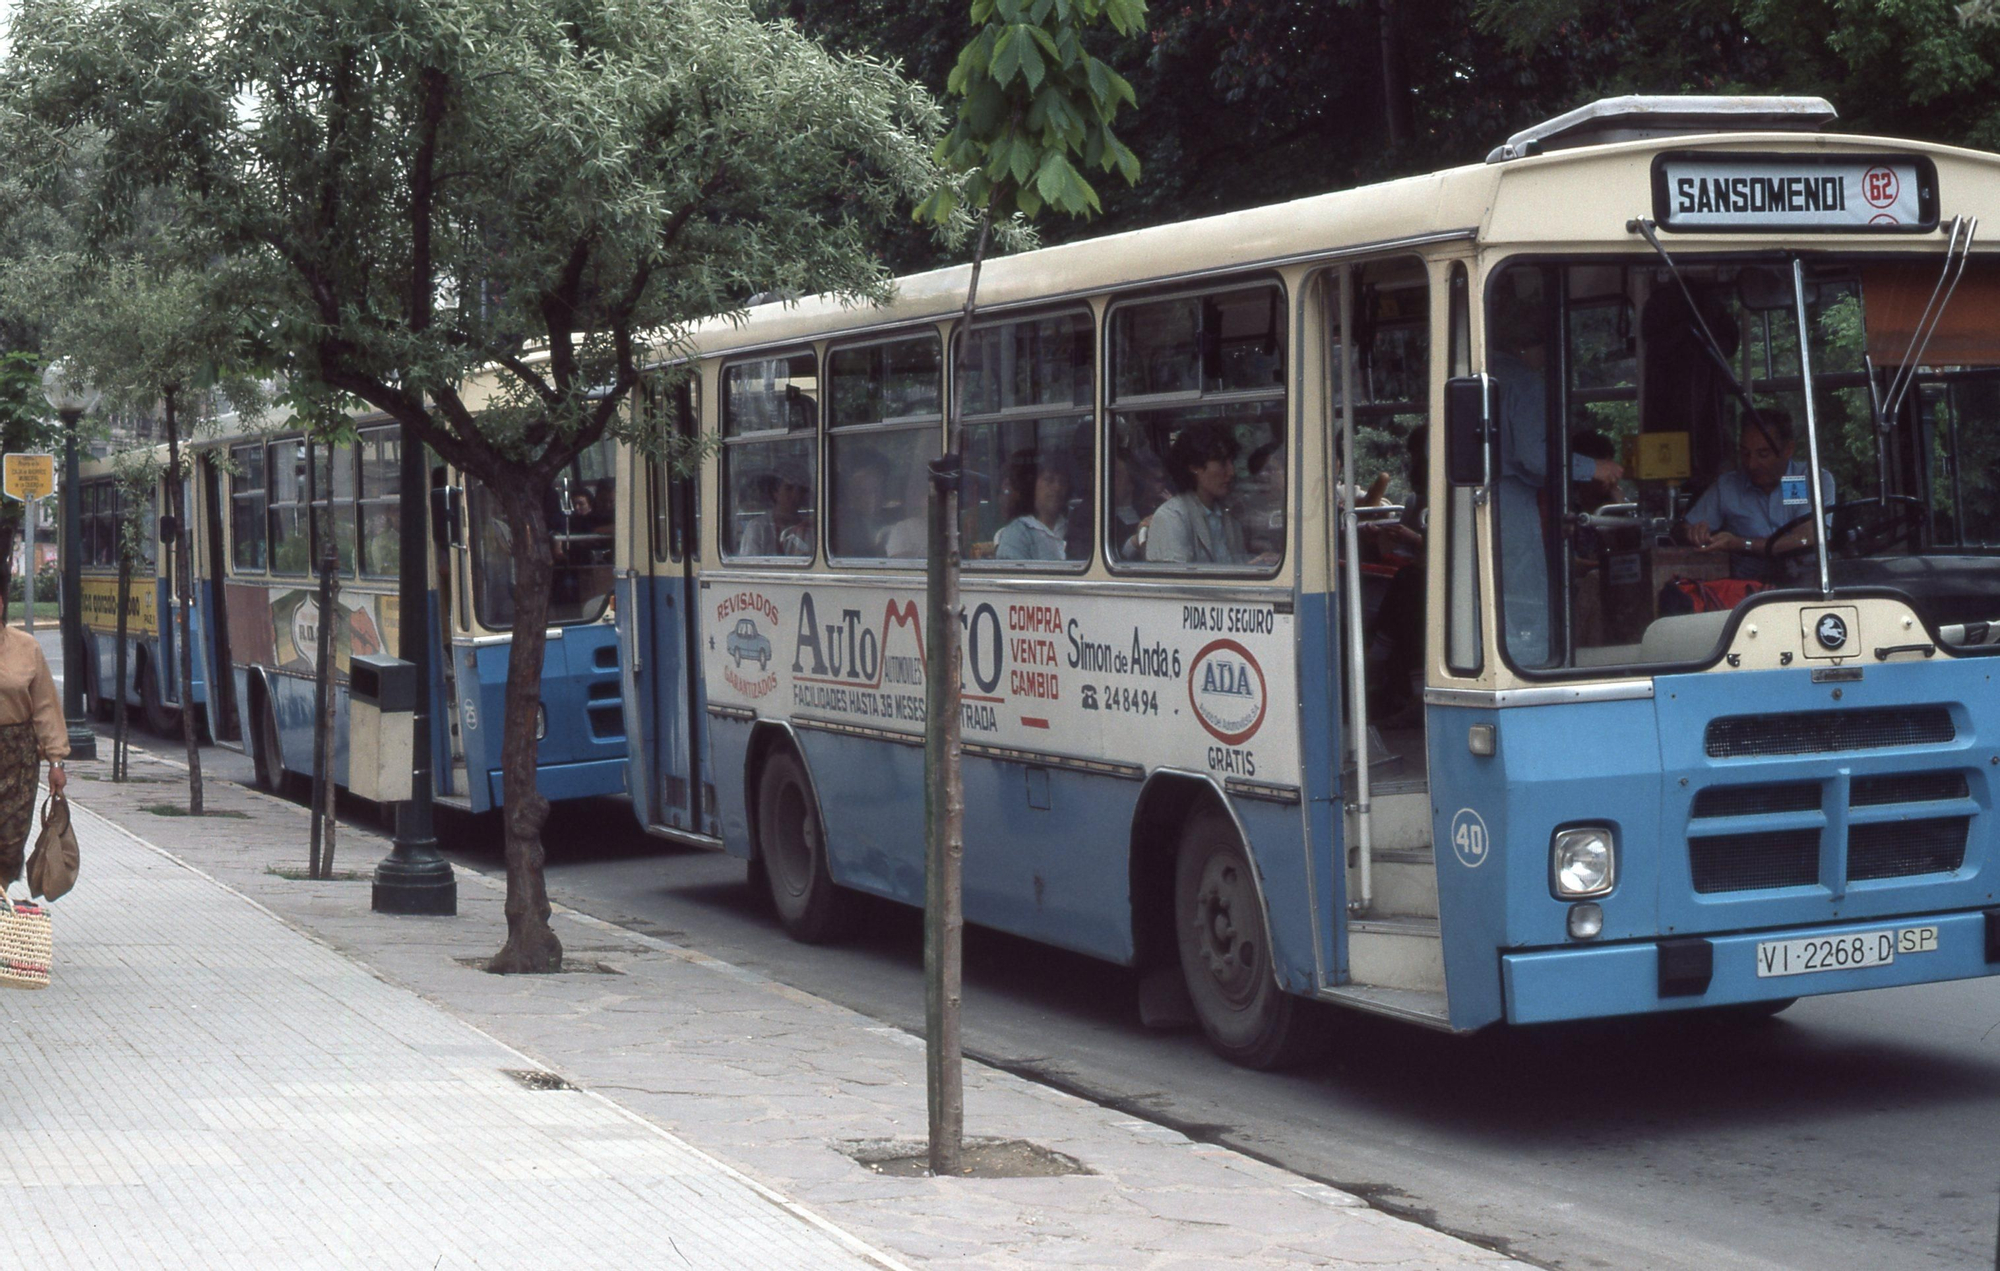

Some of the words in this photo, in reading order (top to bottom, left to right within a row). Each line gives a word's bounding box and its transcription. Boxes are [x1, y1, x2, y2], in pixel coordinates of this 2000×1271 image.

[1677, 176, 1846, 213] SANSOMENDI
[1869, 172, 1893, 201] 62
[717, 592, 778, 626] REVISADOS
[1009, 605, 1063, 634] COMPRA
[1183, 605, 1207, 631] PIDA
[1210, 607, 1223, 632] SU
[1227, 608, 1274, 635] SEGURO
[1010, 638, 1058, 667] VENTA
[1067, 618, 1112, 673] Simon
[1114, 651, 1128, 674] de
[724, 665, 777, 699] GARANTIZADOS
[1011, 669, 1059, 700] CAMBIO
[1201, 660, 1254, 698] ADA
[793, 684, 847, 712] FACILIDADES
[850, 690, 879, 717] HASTA
[880, 694, 893, 718] 36
[895, 694, 926, 723] MESES
[1208, 746, 1255, 776] GRATIS
[1456, 823, 1482, 854] 40
[1902, 928, 1934, 951] SP
